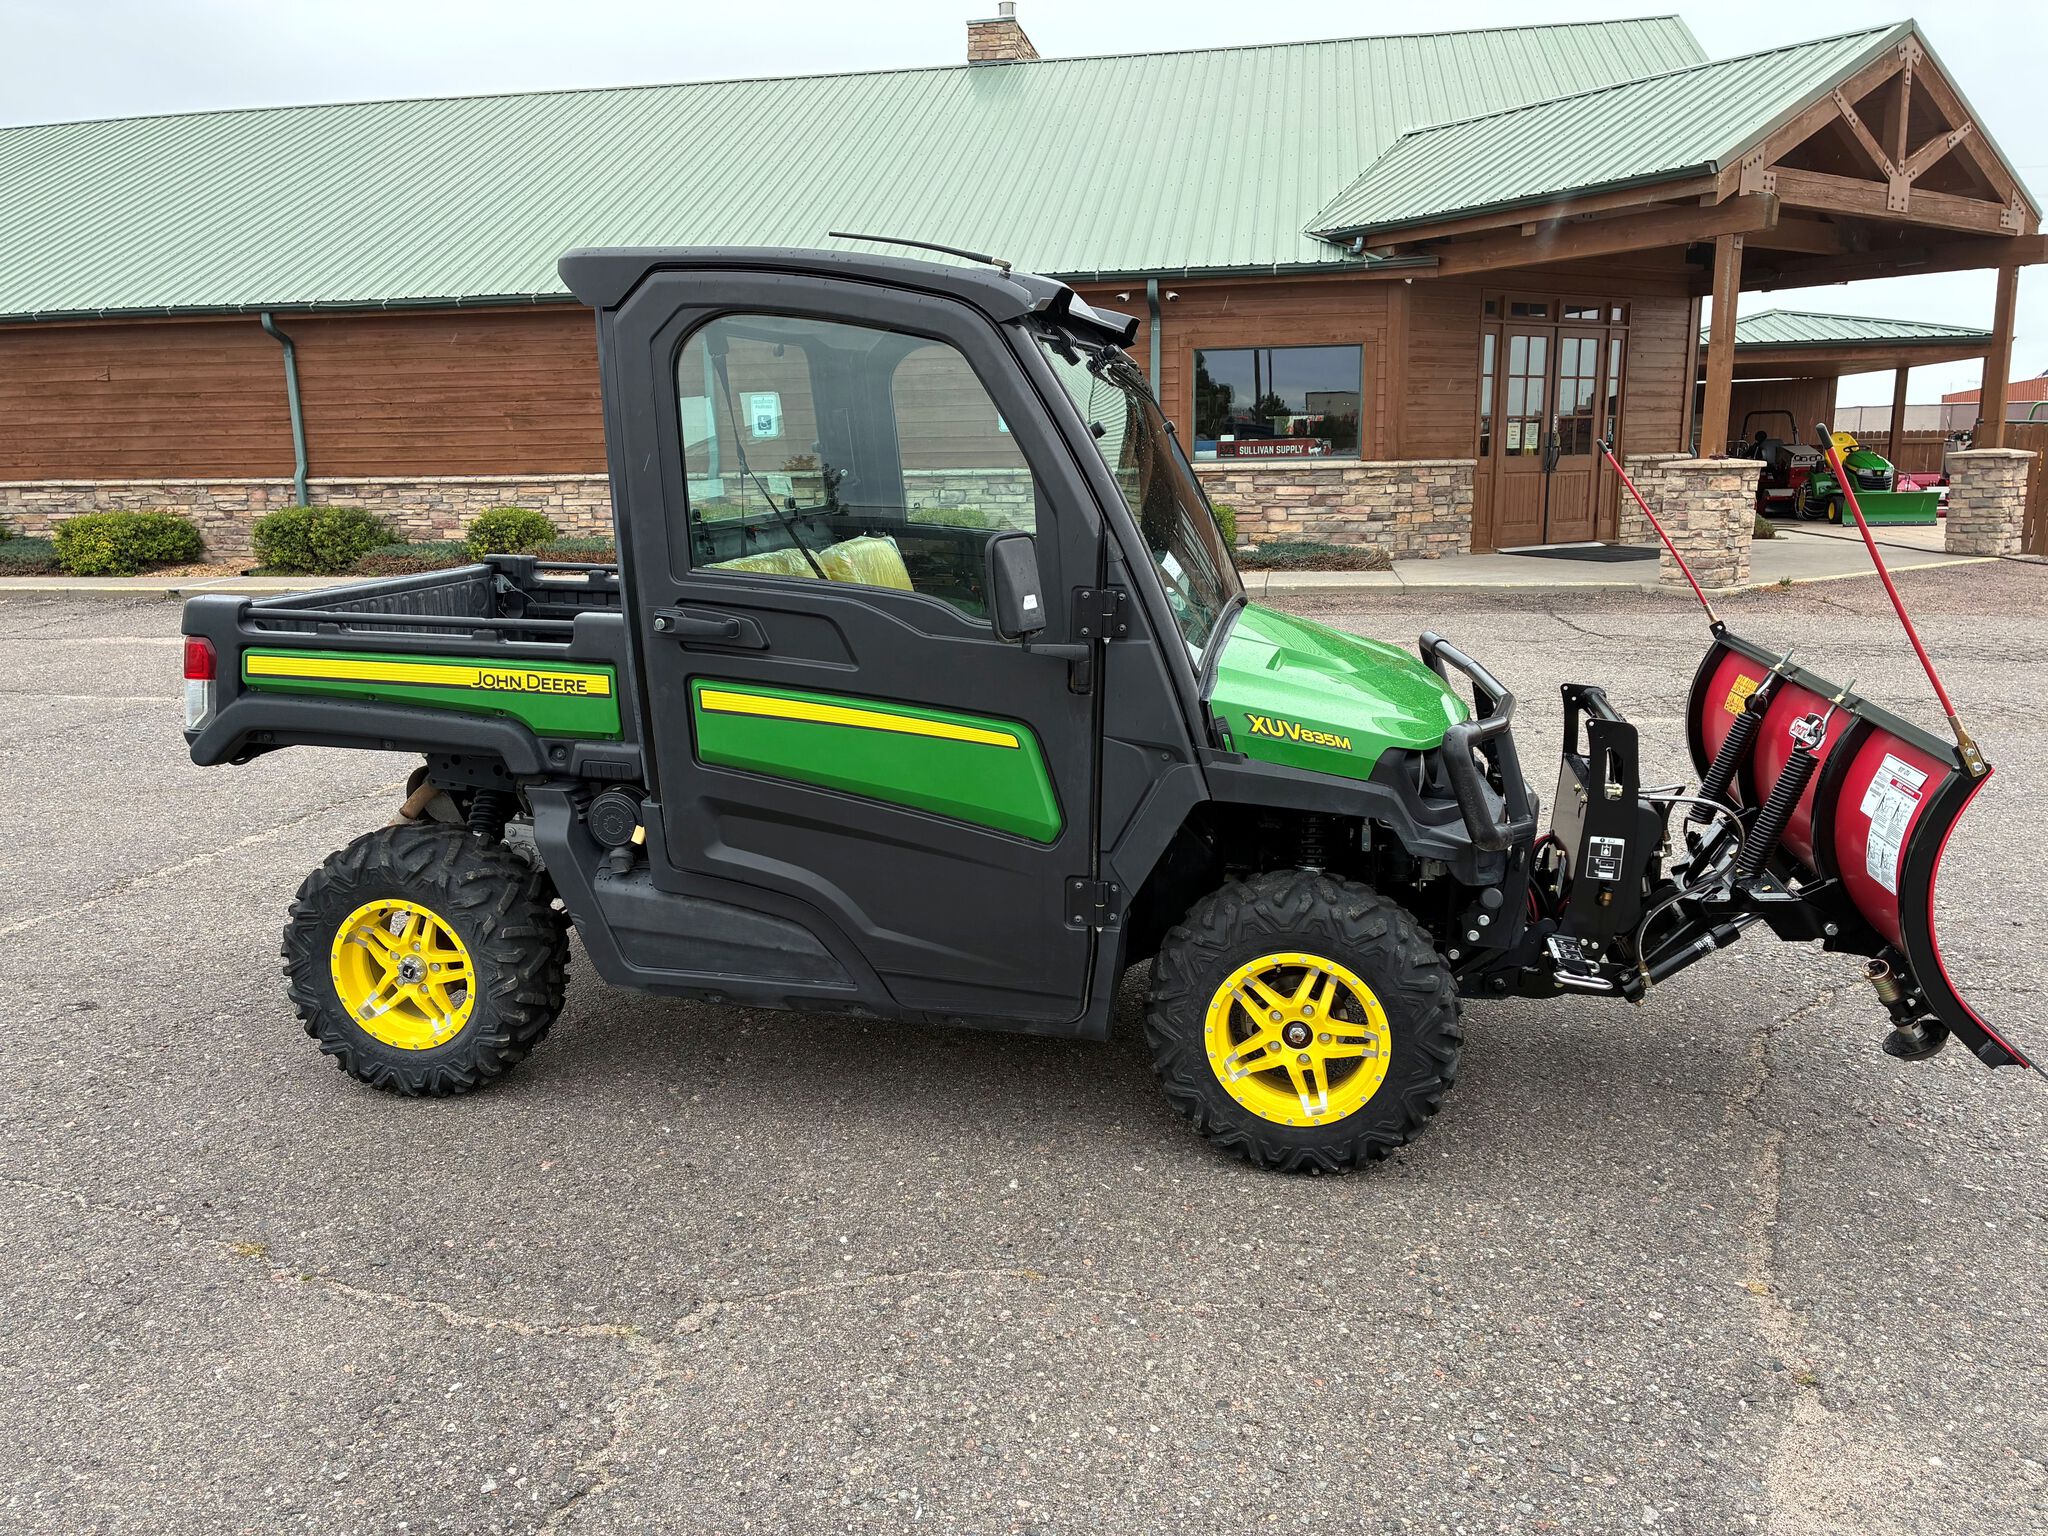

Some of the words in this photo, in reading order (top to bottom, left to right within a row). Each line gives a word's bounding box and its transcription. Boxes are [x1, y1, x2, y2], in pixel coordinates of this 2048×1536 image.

[1239, 445, 1275, 455] SULLIVAN
[1276, 445, 1304, 454] SUPPLY
[472, 670, 522, 689] JOHN
[526, 673, 588, 693] DEERE
